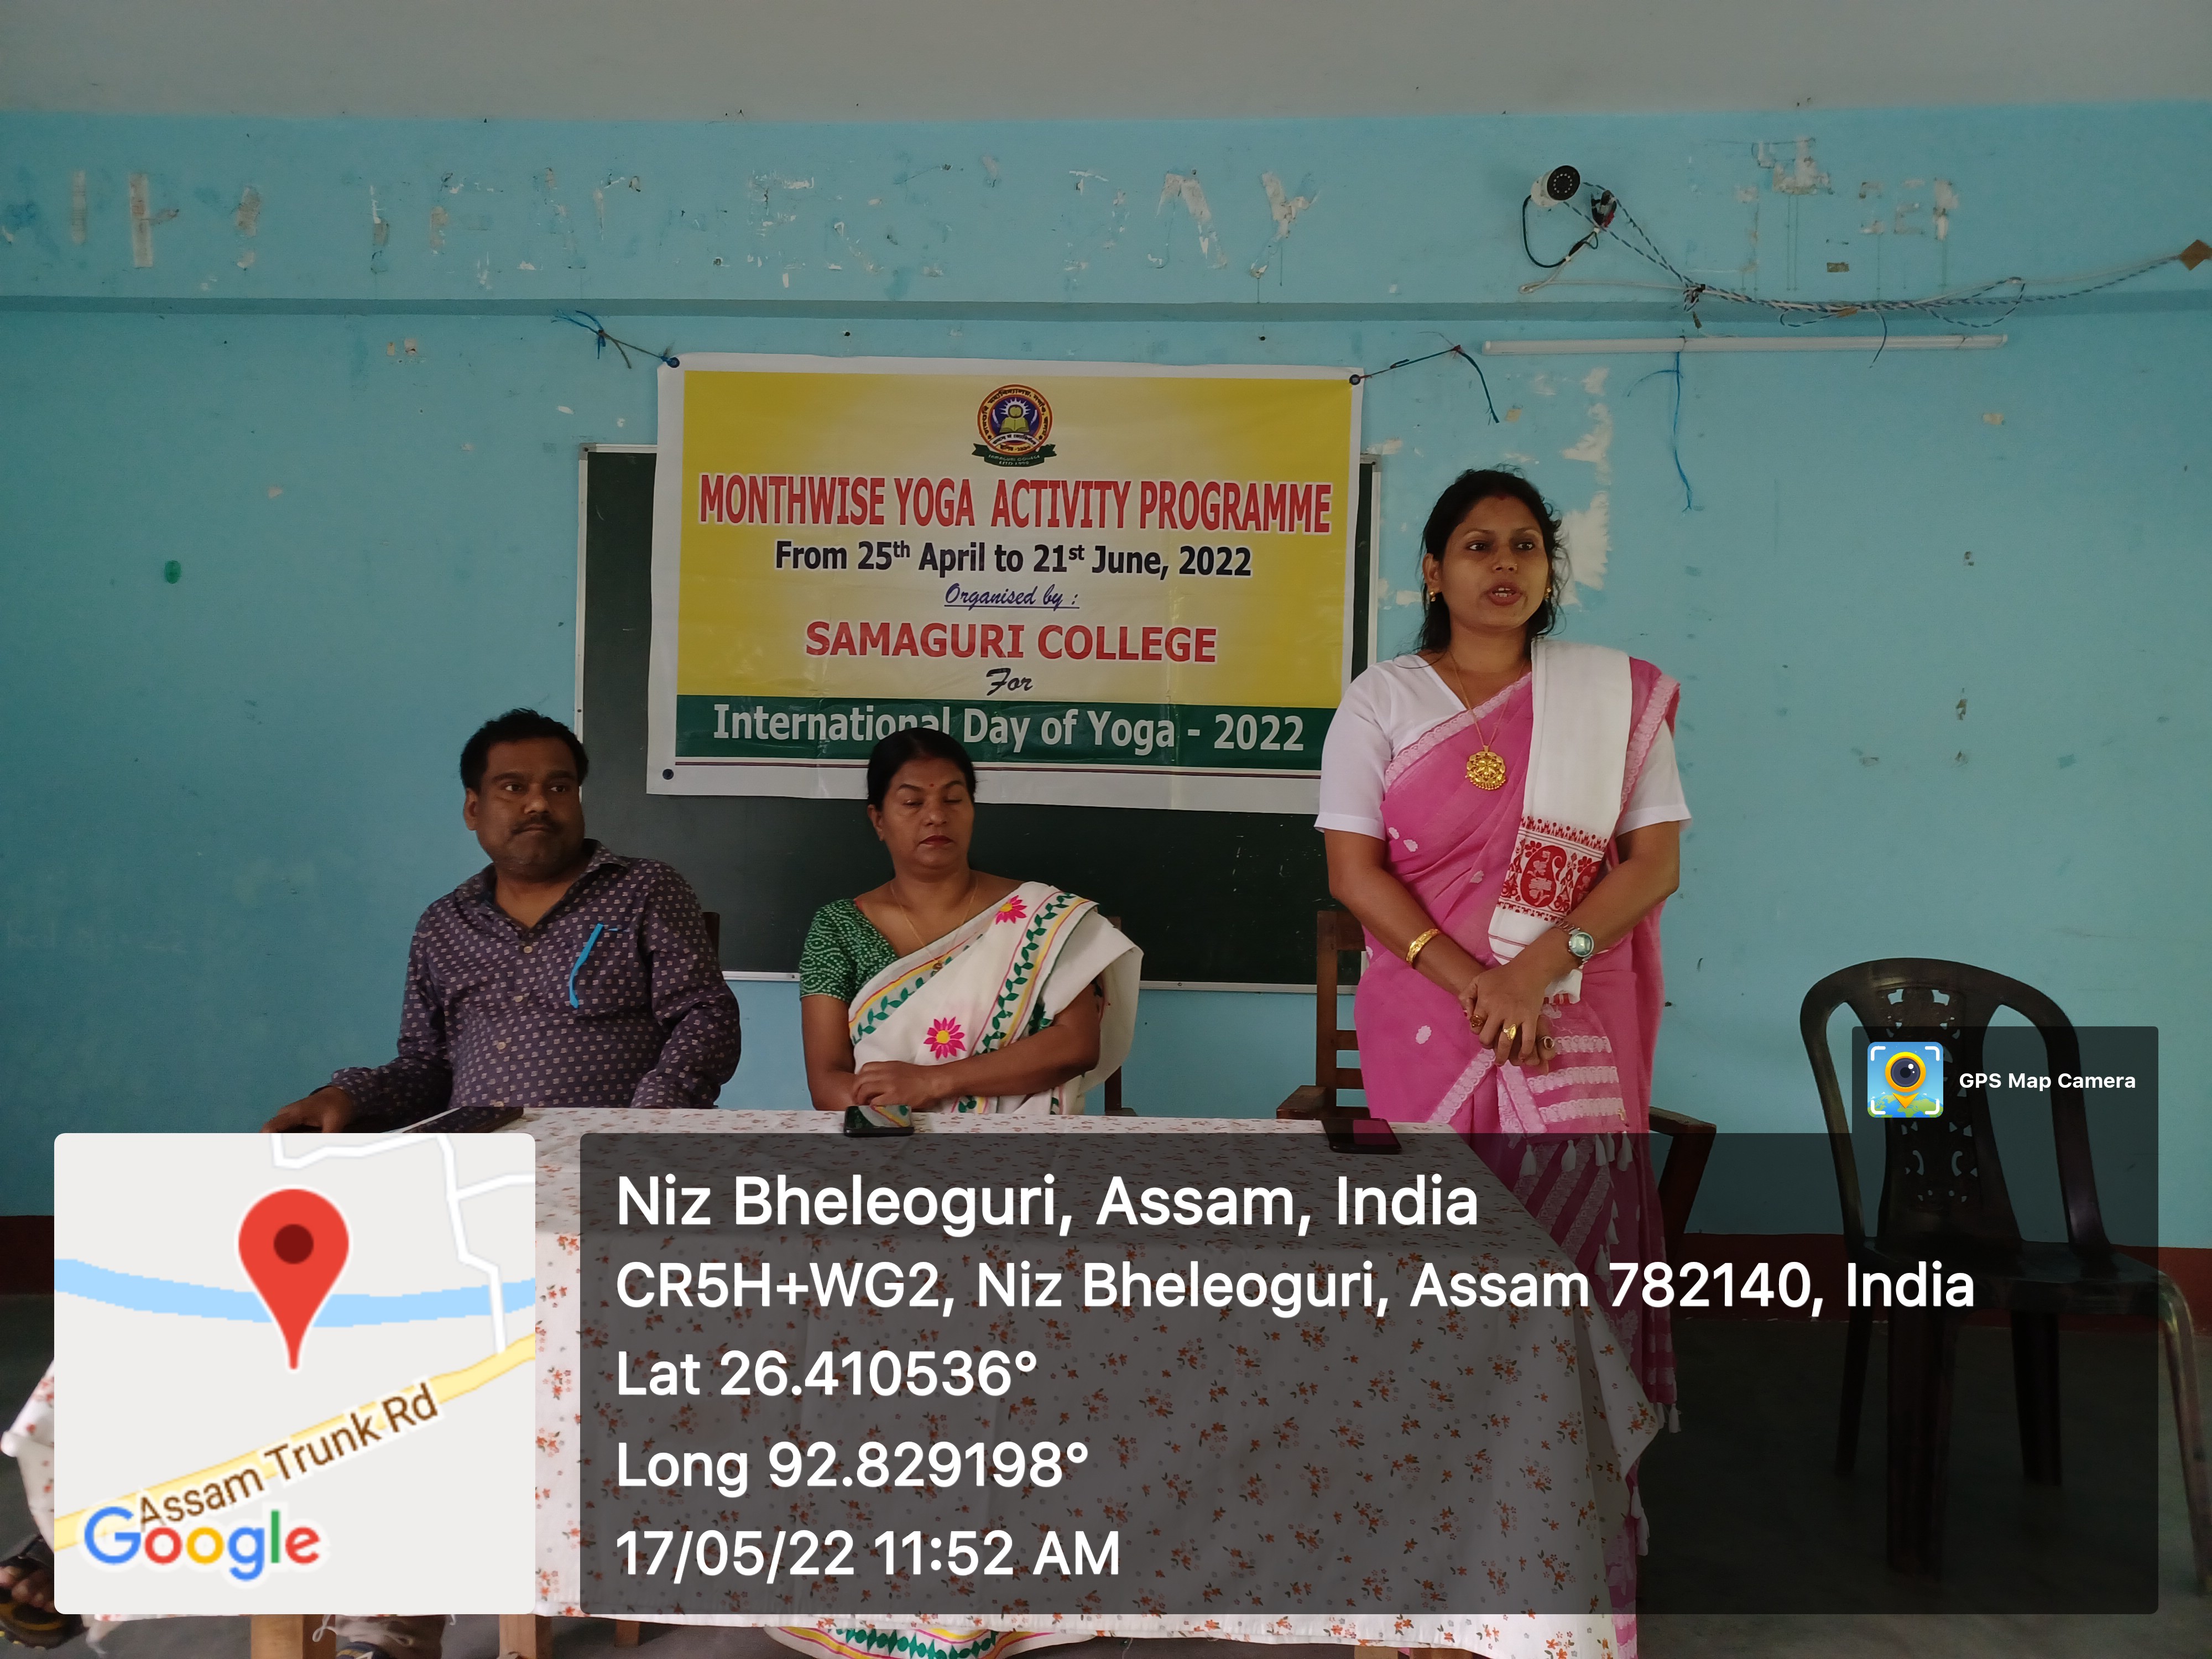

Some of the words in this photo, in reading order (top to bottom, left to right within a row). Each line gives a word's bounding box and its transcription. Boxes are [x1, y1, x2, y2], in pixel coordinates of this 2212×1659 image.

[701, 474, 885, 525] MONTHWISE
[894, 477, 975, 527] YOGA
[990, 479, 1131, 529] ACTIVITY
[1140, 480, 1332, 533] PROGRAMME
[776, 540, 847, 570] From
[858, 540, 910, 570] 25th
[918, 541, 985, 578] April
[994, 544, 1024, 572] to
[1034, 544, 1085, 572] 21st
[1091, 545, 1169, 581] June,
[1179, 545, 1251, 576] 2022
[945, 583, 1036, 611] Organised
[1044, 584, 1063, 611] by
[807, 621, 1025, 658] SAMAGURI
[1038, 624, 1217, 662] COLLEGE
[986, 667, 1033, 696] For
[964, 708, 1030, 753] Day
[1041, 708, 1078, 745] of
[1087, 711, 1175, 756] Yoga
[1214, 713, 1304, 751] 2022
